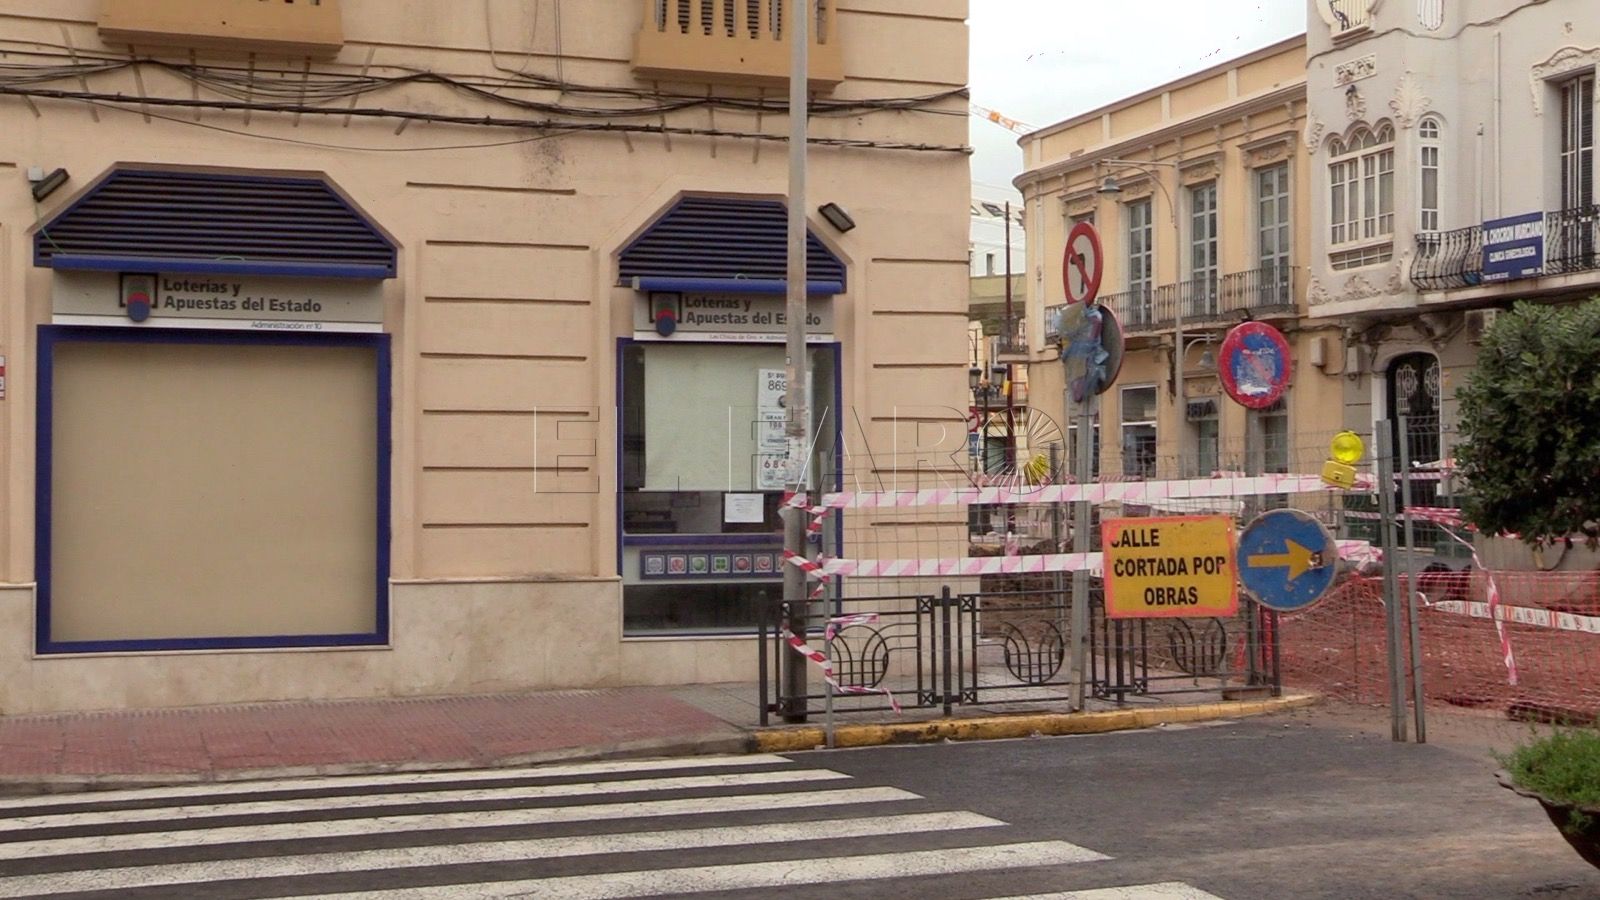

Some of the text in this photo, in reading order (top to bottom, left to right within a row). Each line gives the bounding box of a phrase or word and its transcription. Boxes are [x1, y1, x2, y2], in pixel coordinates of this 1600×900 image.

[232, 283, 241, 297] y
[164, 296, 322, 313] Apuestas del Estado
[744, 299, 751, 312] y
[686, 311, 748, 326] Apuestas
[752, 311, 771, 325] del
[1114, 557, 1188, 577] CORTADA
[1144, 586, 1198, 606] OBRAS
